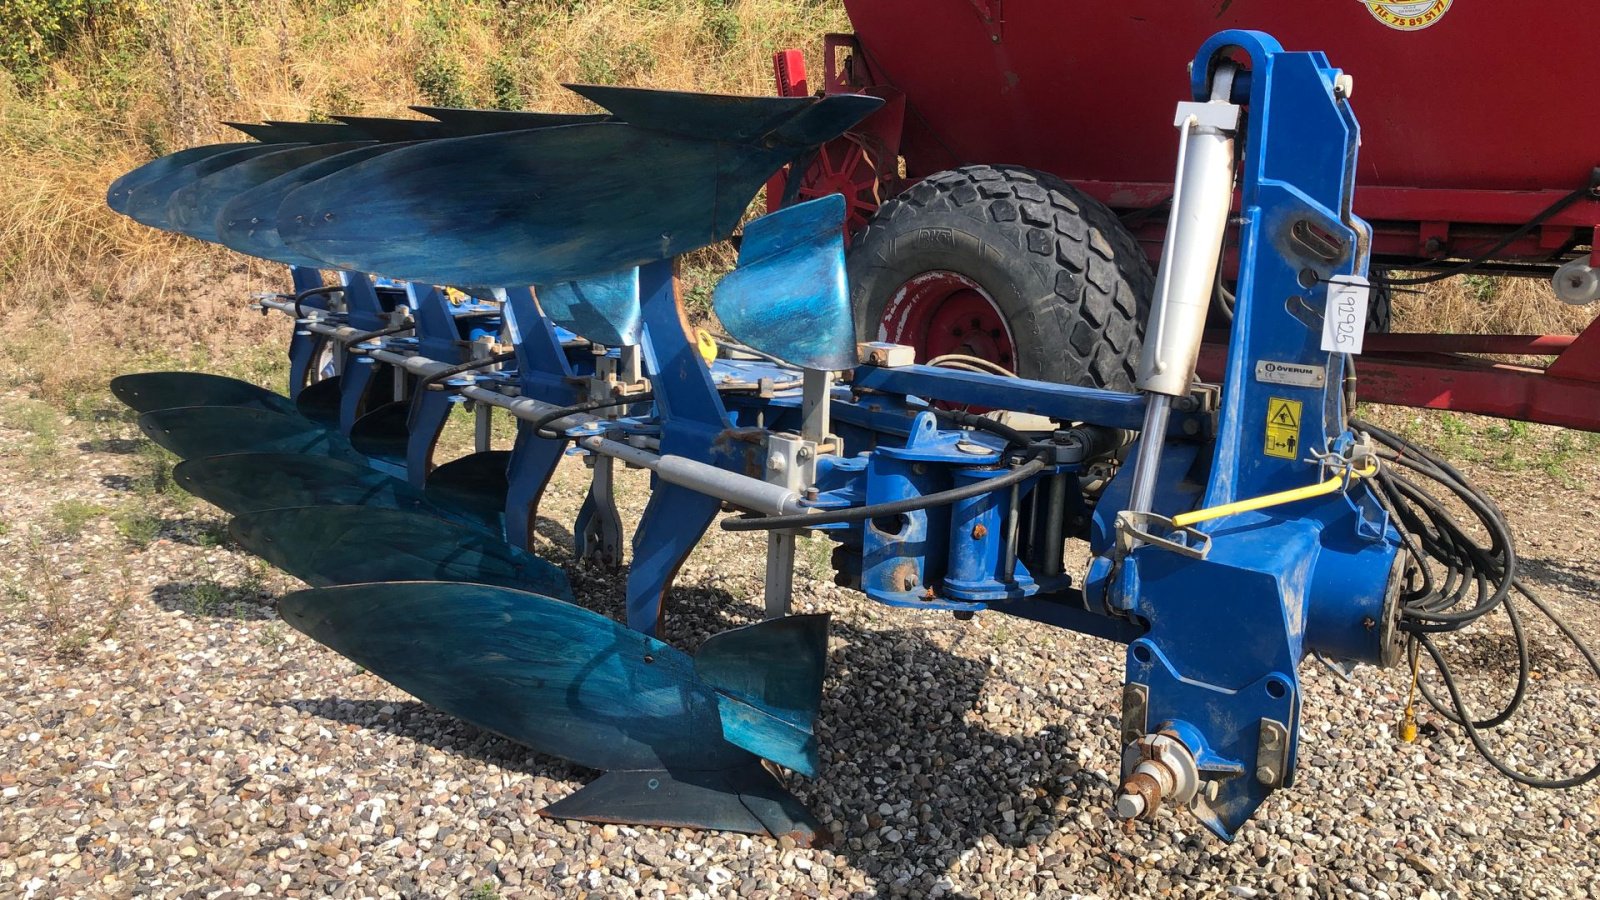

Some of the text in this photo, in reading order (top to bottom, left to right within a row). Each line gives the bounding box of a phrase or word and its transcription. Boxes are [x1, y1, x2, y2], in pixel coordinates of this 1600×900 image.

[1375, 0, 1444, 26] TLF. 75 89 51 77
[1336, 290, 1356, 346] 192925
[1276, 365, 1313, 374] ÖVERUM
